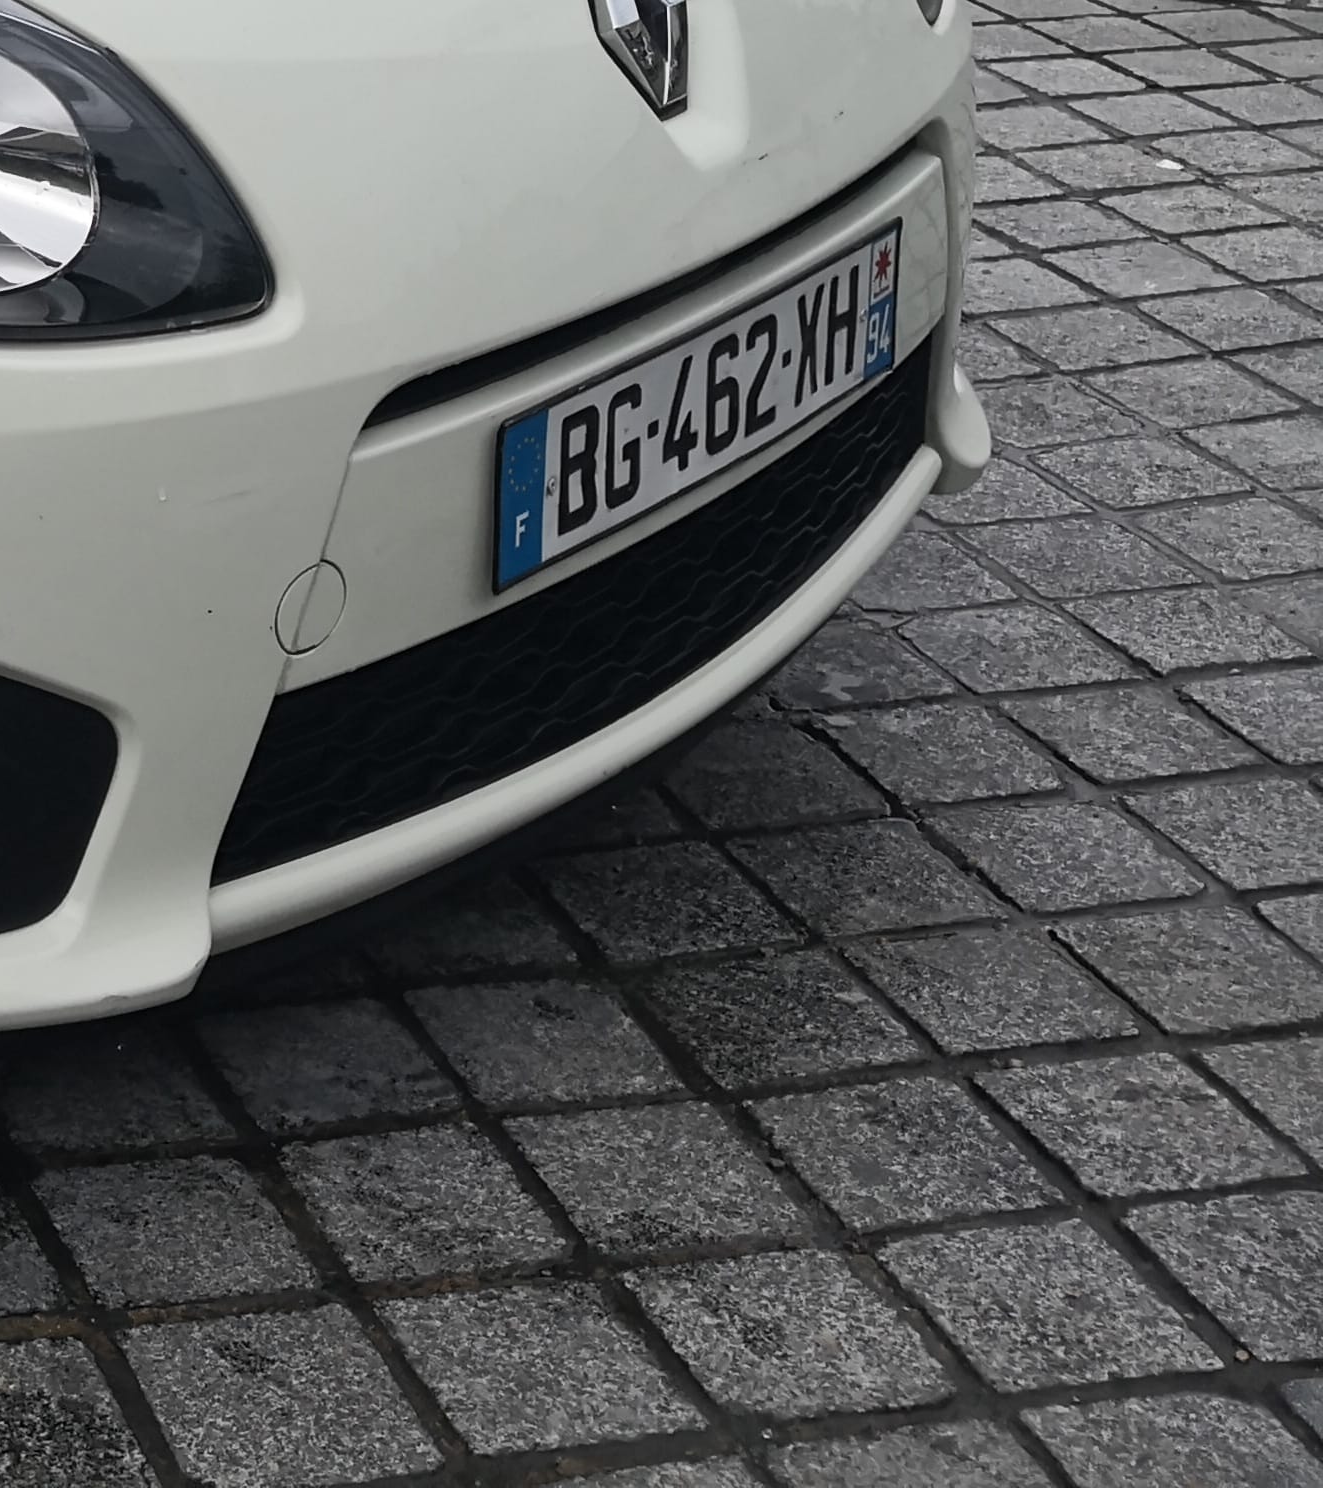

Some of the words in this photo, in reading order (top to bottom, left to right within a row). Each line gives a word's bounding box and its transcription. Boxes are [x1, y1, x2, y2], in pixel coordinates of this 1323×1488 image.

[866, 303, 890, 364] 94
[557, 264, 860, 537] BG-462-XH
[514, 510, 530, 549] F
